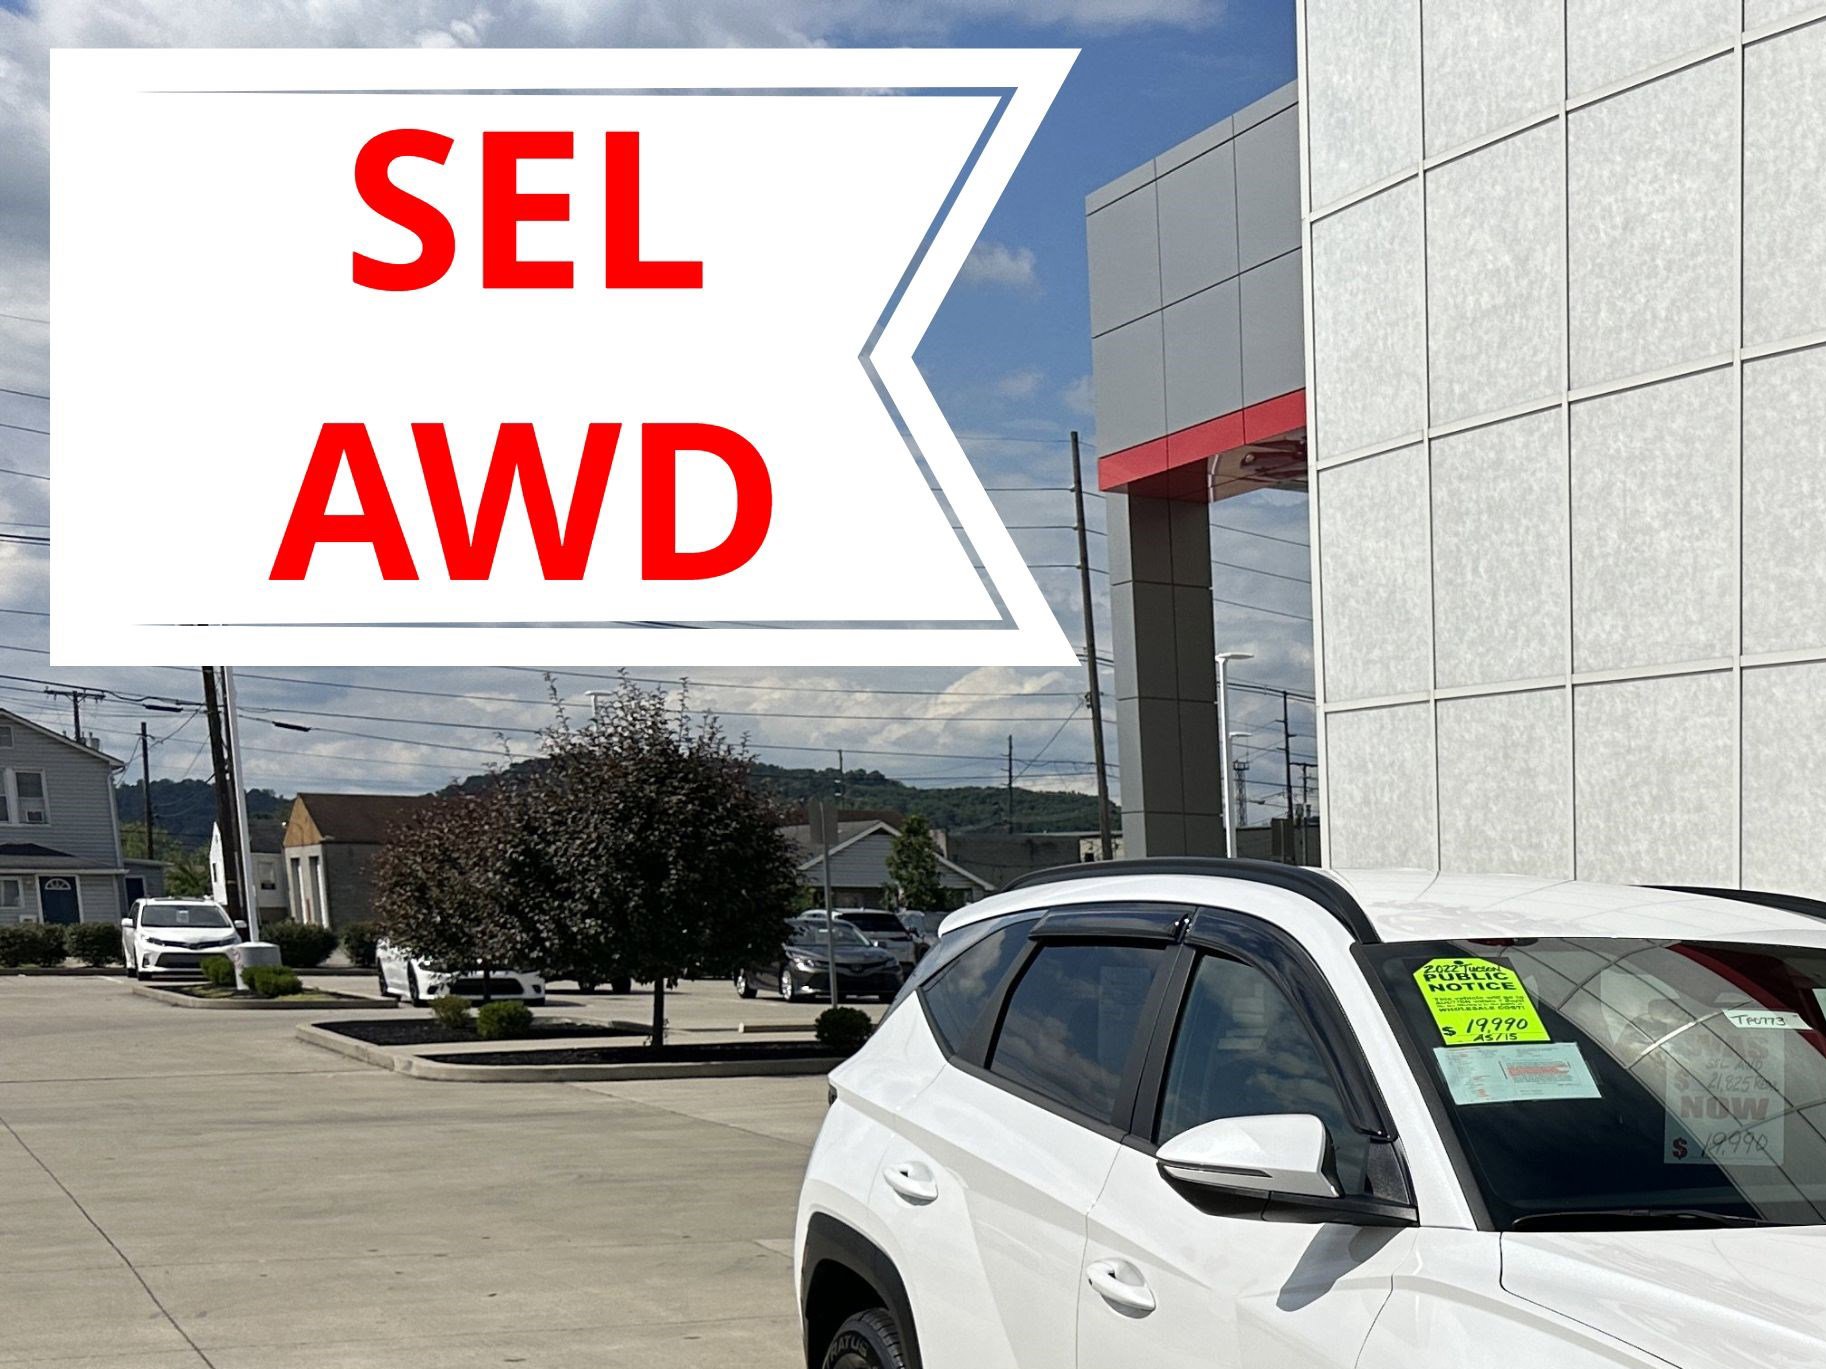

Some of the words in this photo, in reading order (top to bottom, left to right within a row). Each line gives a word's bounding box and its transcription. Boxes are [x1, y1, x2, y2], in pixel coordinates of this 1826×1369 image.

[1423, 964, 1459, 974] 2022
[1423, 972, 1508, 982] PUBLIC
[1428, 982, 1517, 992] NOTICE
[1442, 1026, 1456, 1036] $
[1466, 1017, 1528, 1033] 19,990
[1679, 1094, 1770, 1121] NOW
[1672, 1136, 1688, 1160] $
[1700, 1130, 1768, 1158] 19,990
